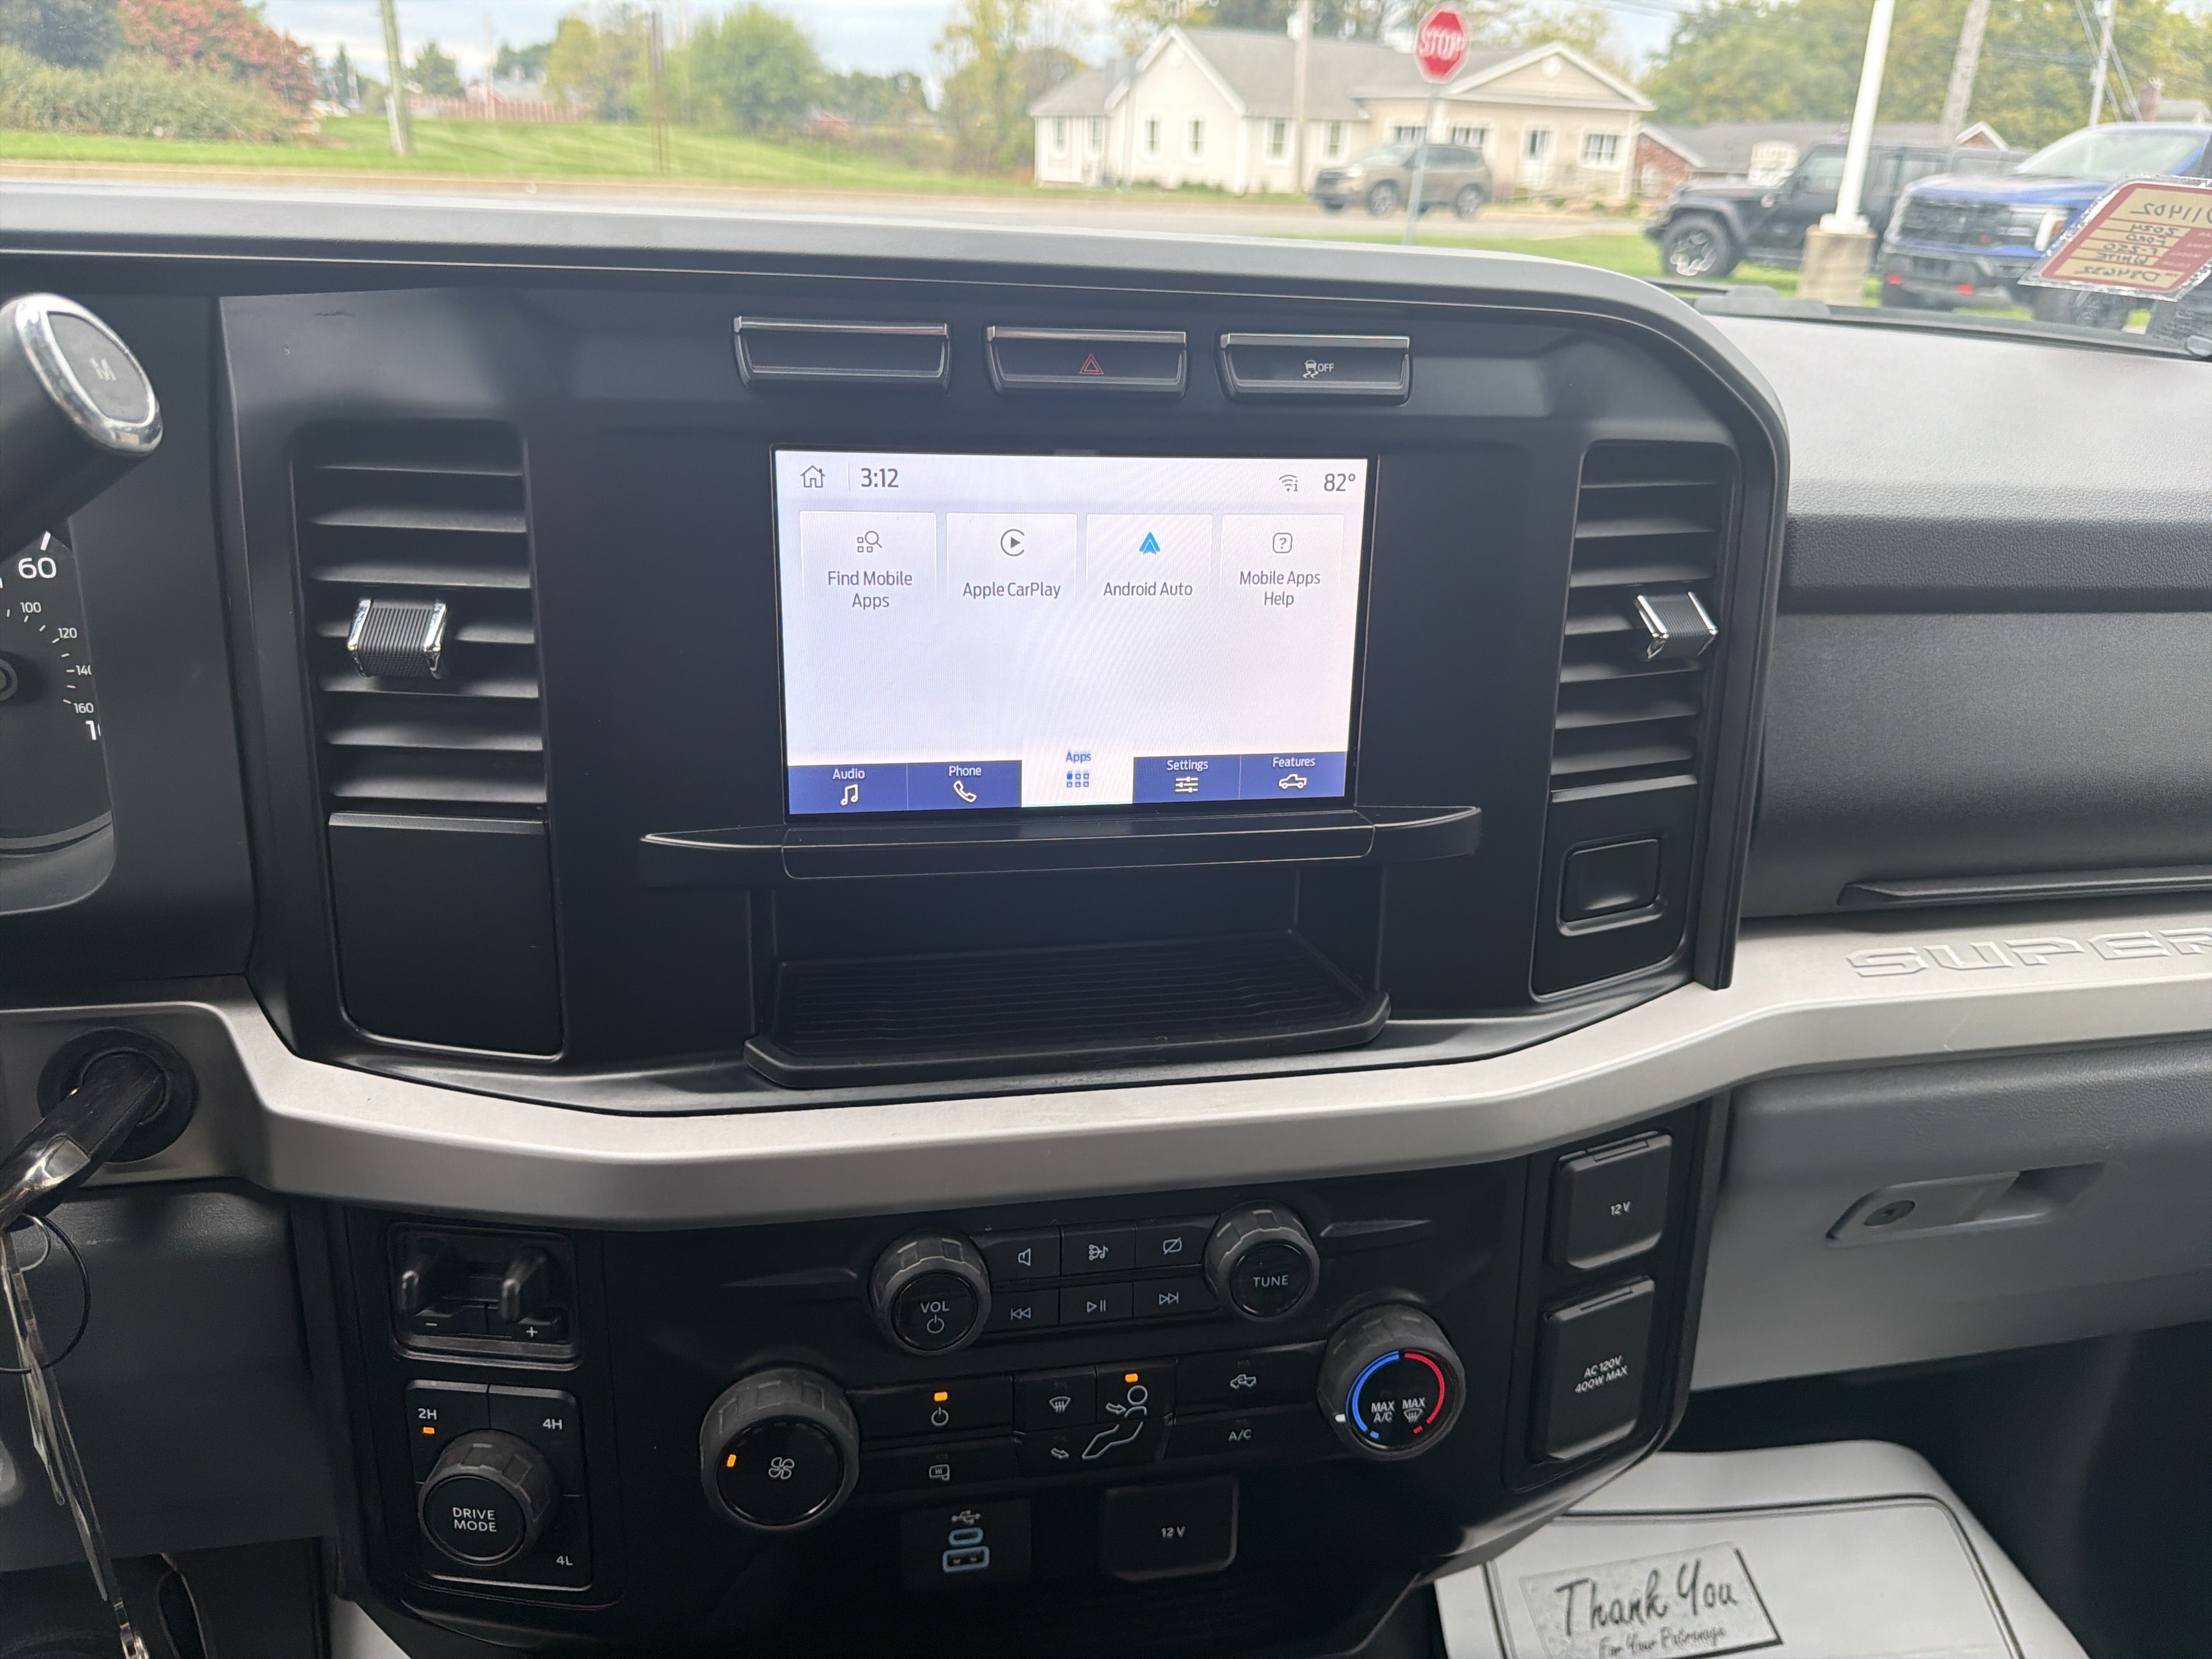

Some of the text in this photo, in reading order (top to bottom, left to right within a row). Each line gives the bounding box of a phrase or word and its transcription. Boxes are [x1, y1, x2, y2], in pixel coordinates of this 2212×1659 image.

[1419, 26, 1464, 61] STOP
[1317, 363, 1335, 373] OFF
[861, 468, 899, 488] 3:12
[1324, 473, 1356, 492] 82°
[18, 557, 57, 579] 60
[827, 571, 913, 586] Find Mobile
[1239, 571, 1321, 587] Mobile Apps
[962, 582, 1061, 600] Apple CarPlay
[1103, 581, 1193, 596] Android Auto
[851, 592, 890, 611] Apps
[1263, 591, 1295, 608] Help
[20, 602, 42, 613] 100
[58, 627, 78, 639] 120
[74, 702, 94, 713] 160
[1065, 751, 1092, 764] Apps
[1272, 757, 1316, 768] Features
[949, 765, 982, 777] Phone
[1166, 759, 1209, 772] Settings
[832, 768, 866, 781] Audio
[1846, 927, 2212, 978] SUPER
[1252, 1274, 1289, 1288] TUNE
[920, 1301, 950, 1314] VOL
[1583, 1355, 1623, 1379] AC 120V
[1575, 1364, 1629, 1394] 400W MAX
[1371, 1401, 1396, 1414] MAX
[1402, 1397, 1426, 1410] MAX
[417, 1408, 437, 1420] 2H
[1373, 1411, 1393, 1424] A/C
[543, 1419, 563, 1430] 4H
[1228, 1429, 1252, 1442] A/C
[453, 1507, 495, 1520] DRIVE
[454, 1520, 496, 1532] MODE
[556, 1556, 573, 1566] 4L
[1554, 1558, 1739, 1637] Thank You
